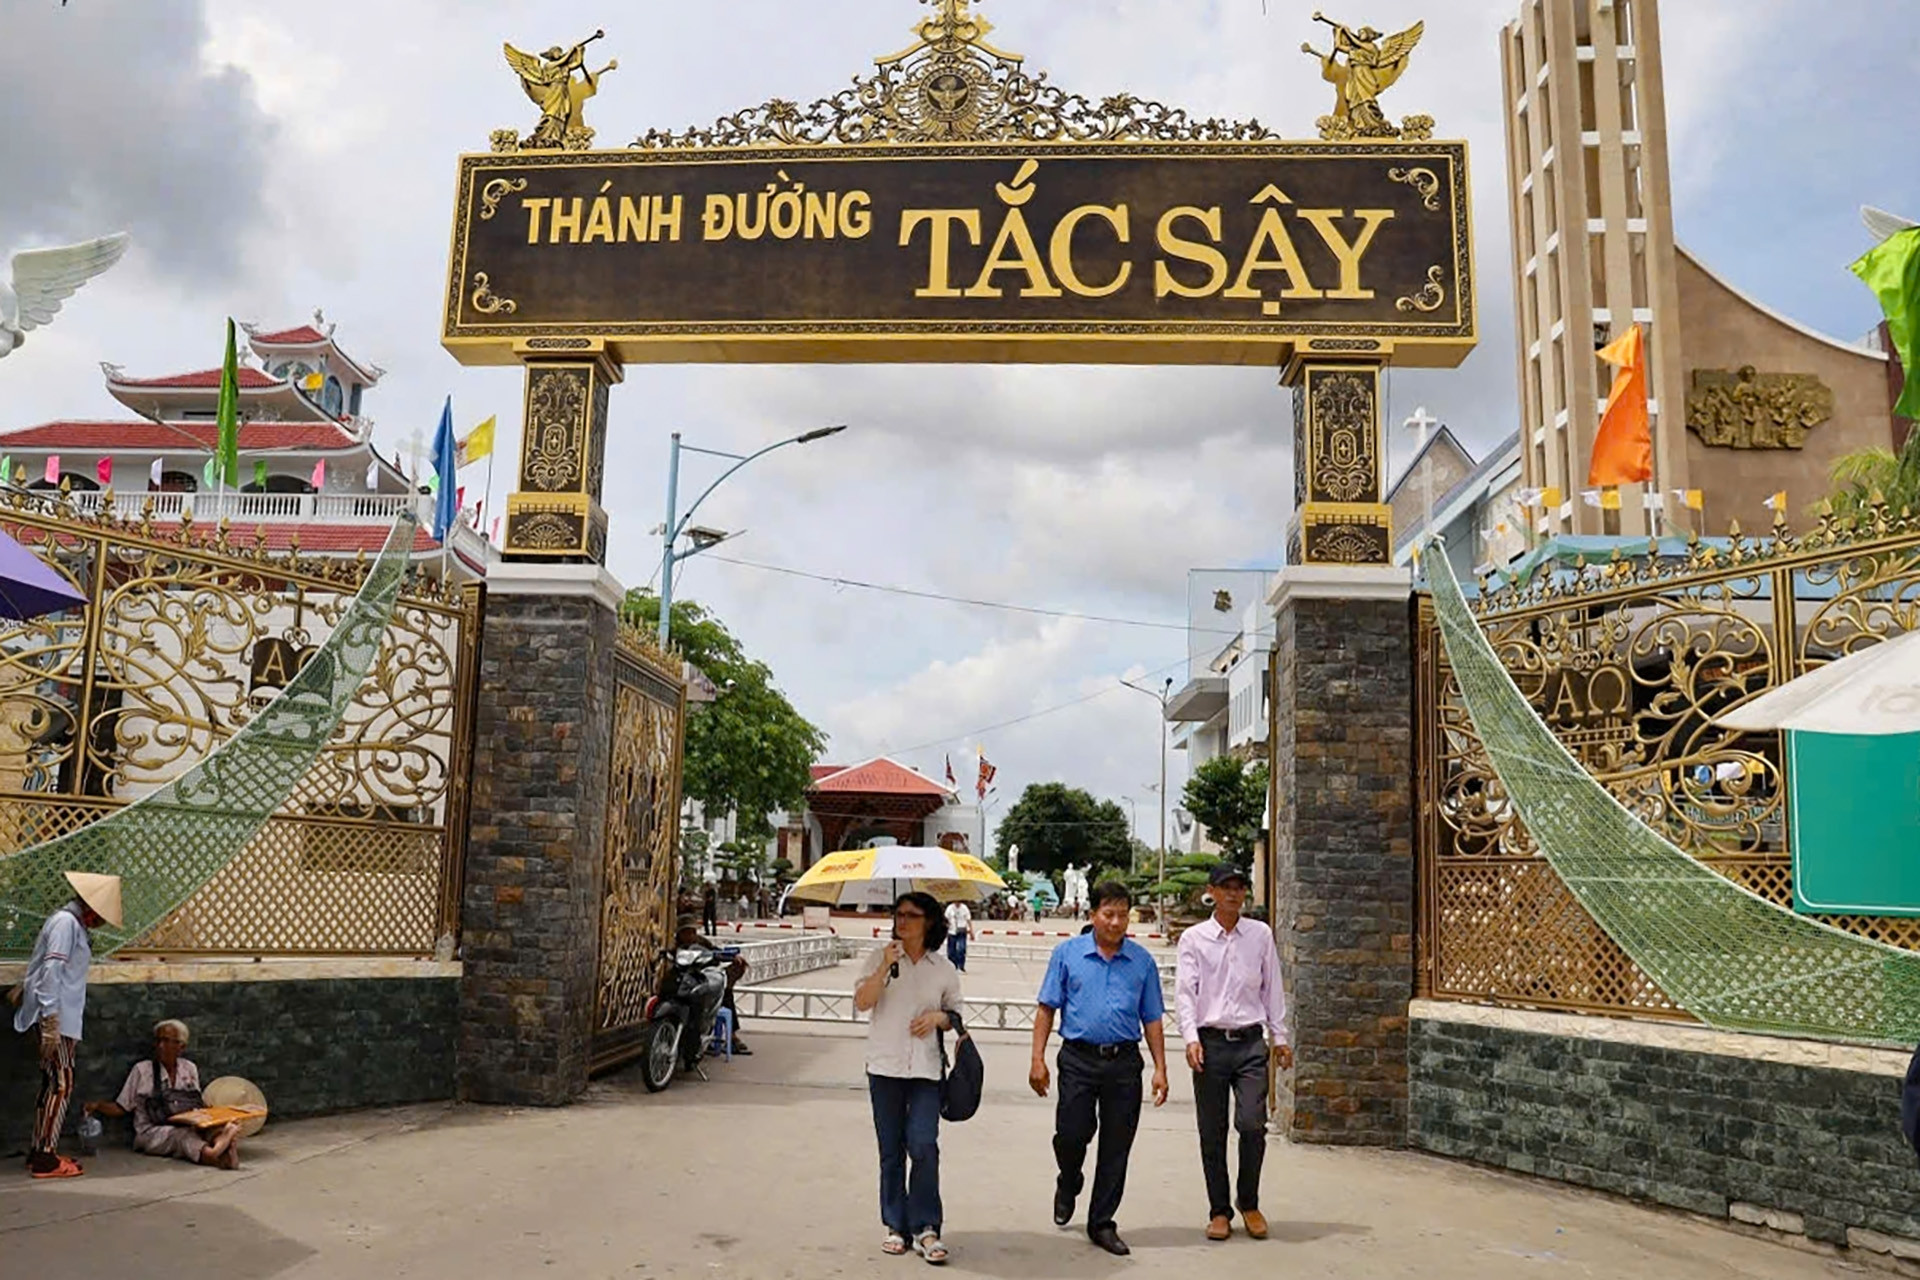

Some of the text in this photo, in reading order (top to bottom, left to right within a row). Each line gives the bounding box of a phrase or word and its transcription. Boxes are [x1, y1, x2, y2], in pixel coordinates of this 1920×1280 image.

[522, 158, 1396, 317] THÁNH ĐƯỜNG TẮC SẬY
